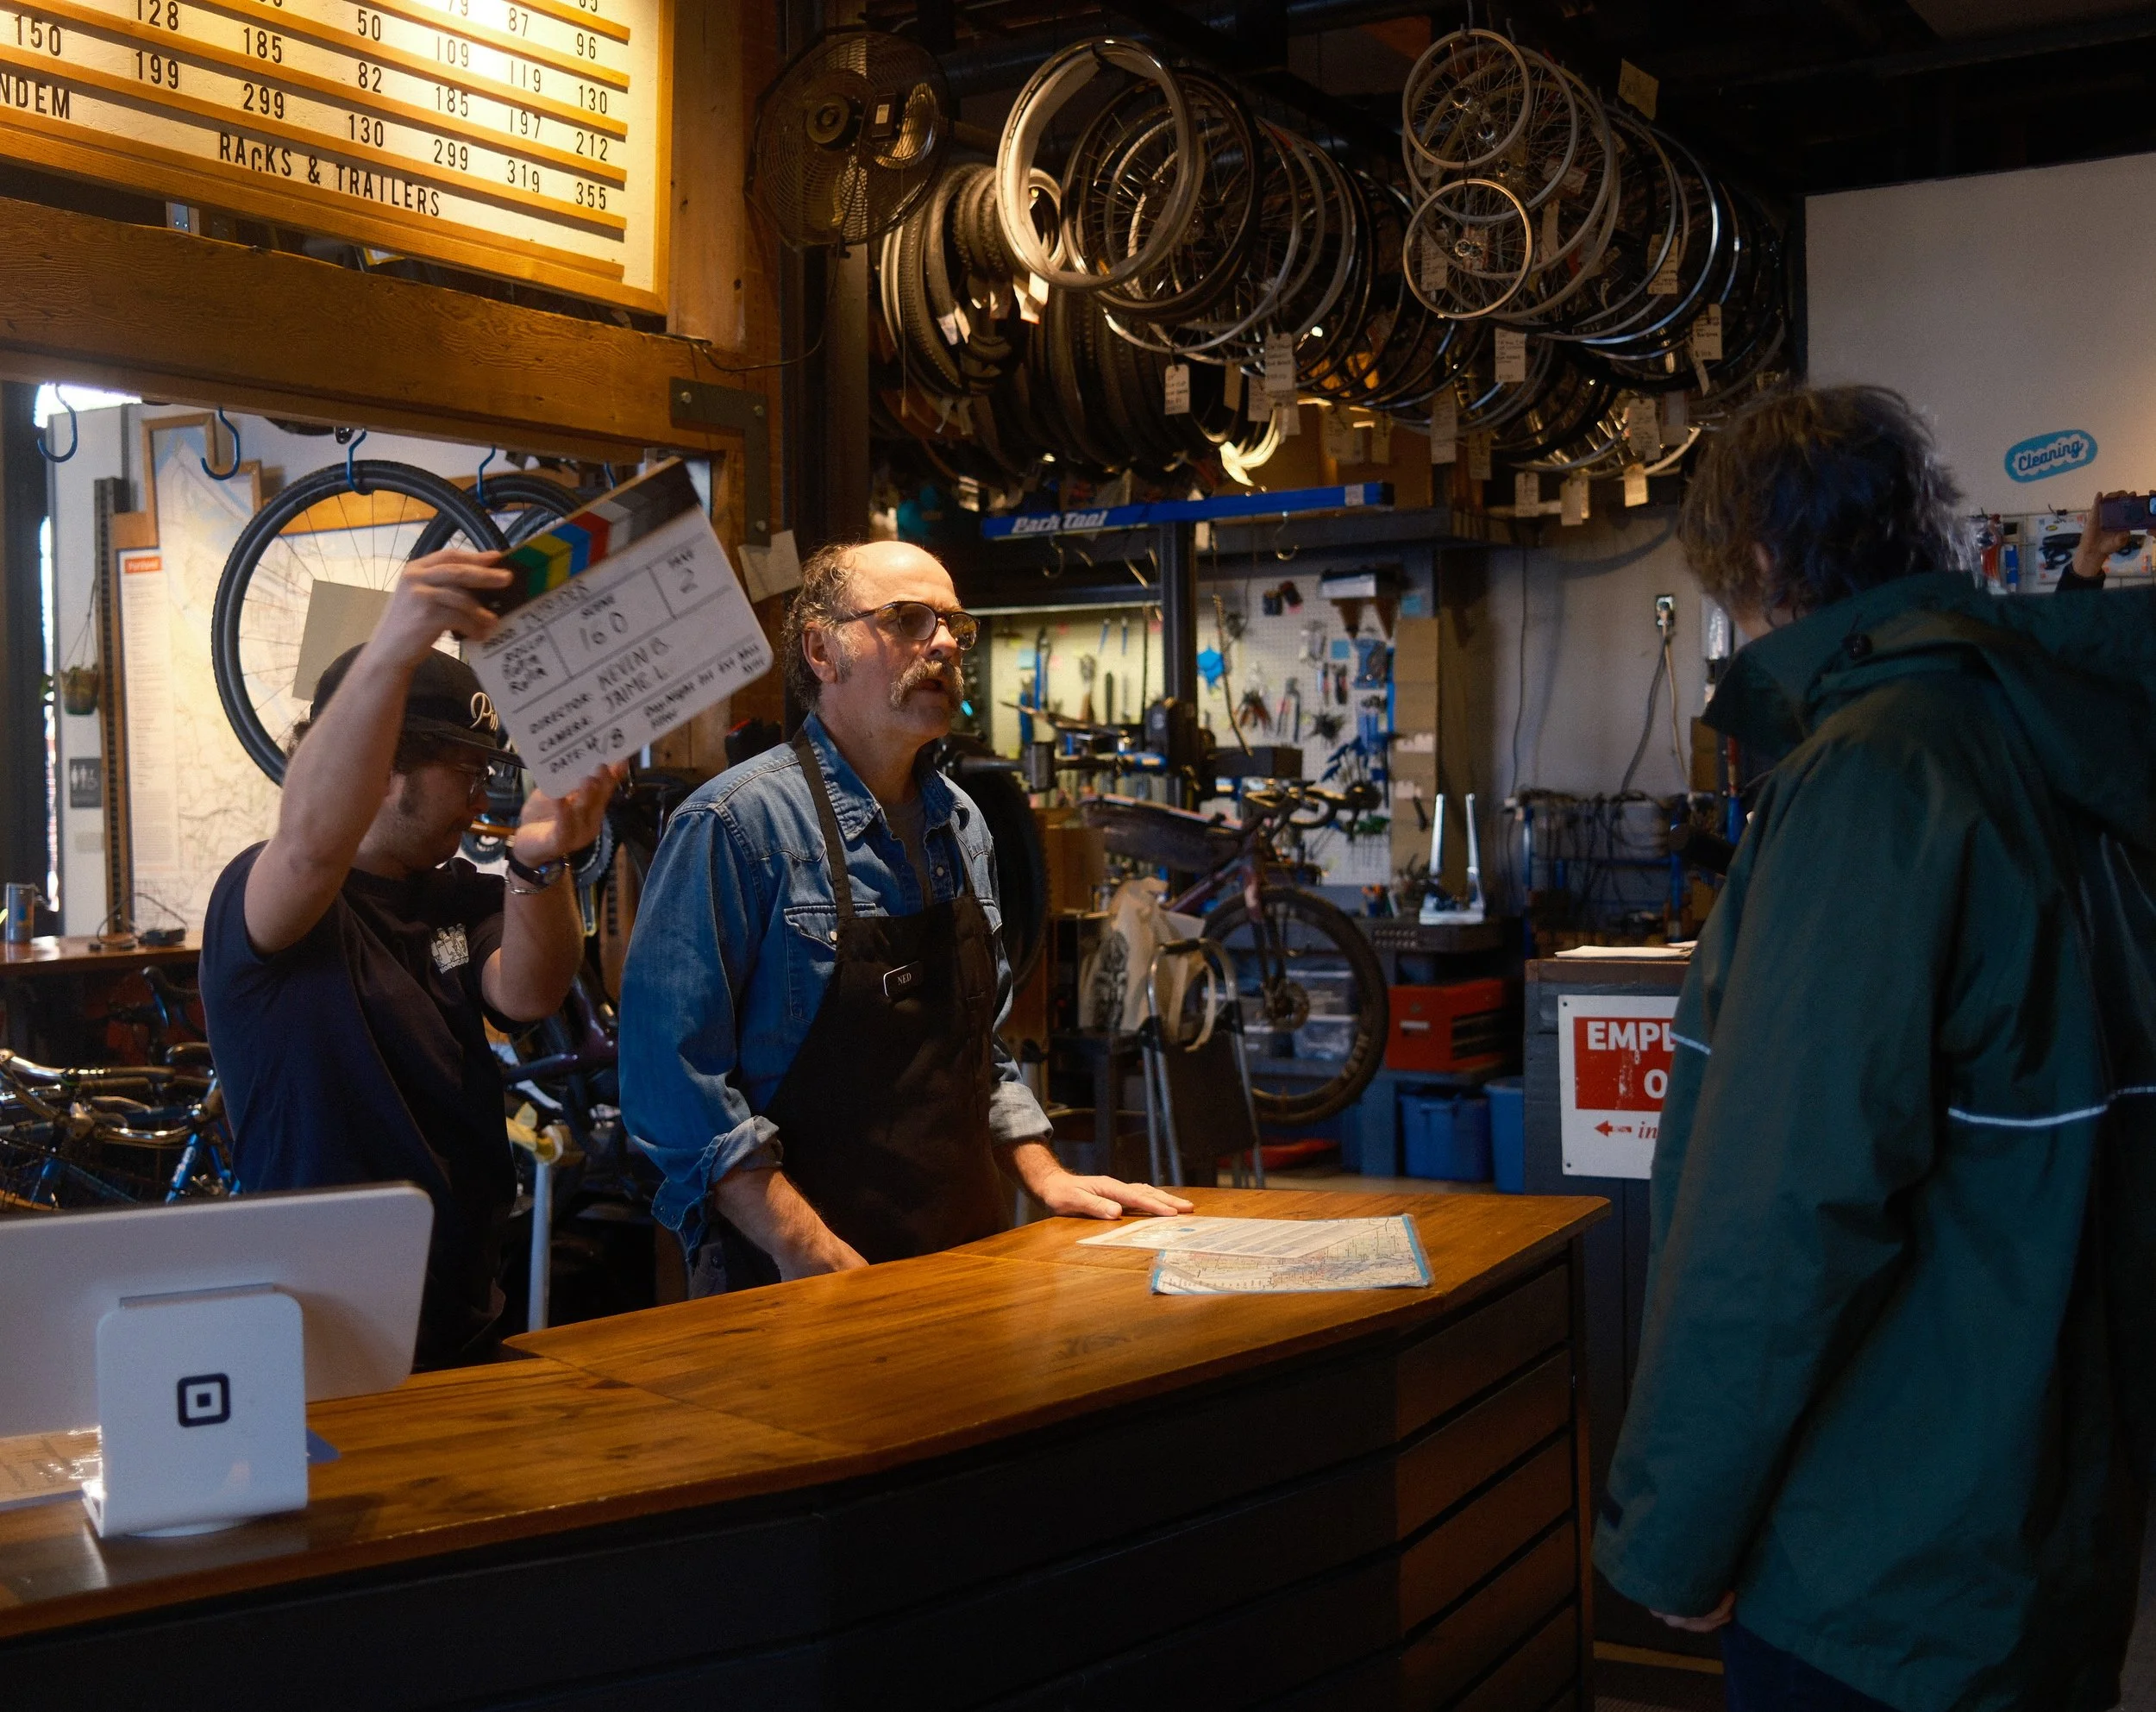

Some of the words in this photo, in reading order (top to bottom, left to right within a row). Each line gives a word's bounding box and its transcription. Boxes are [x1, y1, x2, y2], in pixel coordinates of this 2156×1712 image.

[509, 7, 529, 37] 87
[576, 32, 597, 60] 96
[137, 0, 179, 31] 128
[243, 27, 283, 64] 185
[358, 62, 382, 94] 82
[436, 85, 469, 117] 185
[510, 108, 542, 140] 197
[575, 131, 609, 162] 212
[357, 9, 381, 42] 50
[436, 35, 469, 68] 109
[511, 60, 542, 93] 119
[579, 84, 609, 115] 130
[0, 72, 70, 120] NDEM
[15, 14, 62, 57] 150
[135, 50, 179, 90] 199
[243, 83, 285, 120] 299
[348, 113, 385, 148] 130
[433, 138, 469, 172] 299
[507, 159, 541, 193] 319
[575, 181, 607, 210] 355
[308, 154, 321, 185] &
[335, 163, 440, 216] TRAILERS
[2019, 440, 2084, 471] Cleaning
[898, 972, 912, 986] NED
[1643, 1069, 1669, 1100] O
